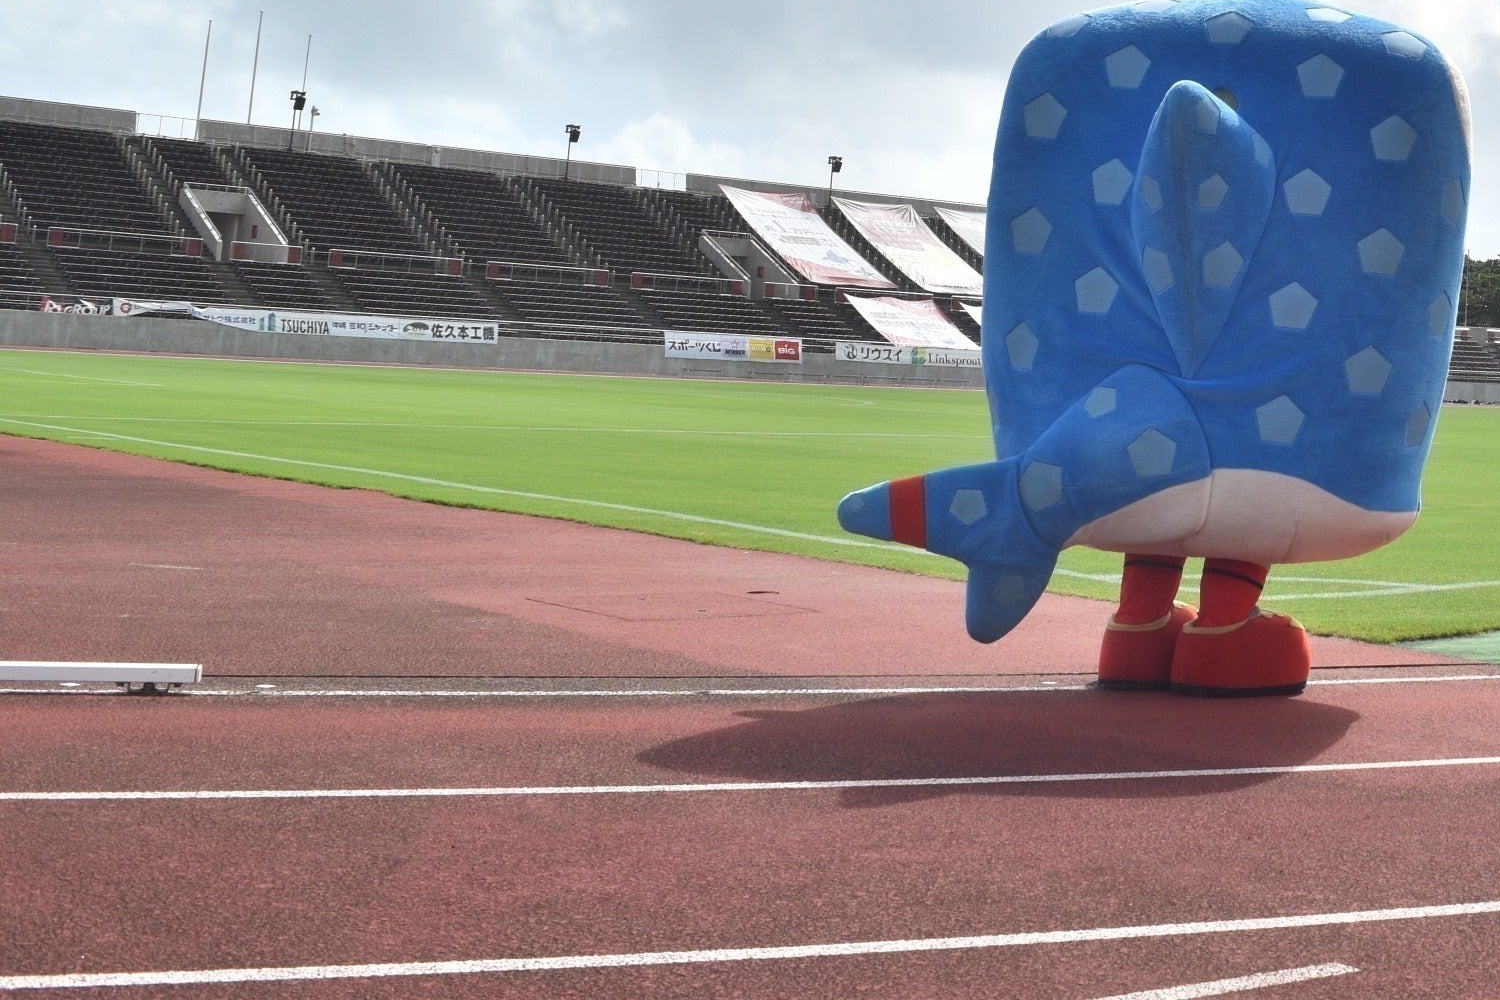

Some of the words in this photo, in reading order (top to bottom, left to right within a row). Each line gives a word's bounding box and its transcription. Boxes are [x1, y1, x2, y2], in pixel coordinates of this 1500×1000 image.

[280, 318, 330, 335] TSUCHIYA
[431, 323, 495, 341] 佐久本工機
[668, 339, 721, 352] スポーツくじ
[860, 347, 903, 361] リウスイ
[928, 352, 981, 367] Linksprout
